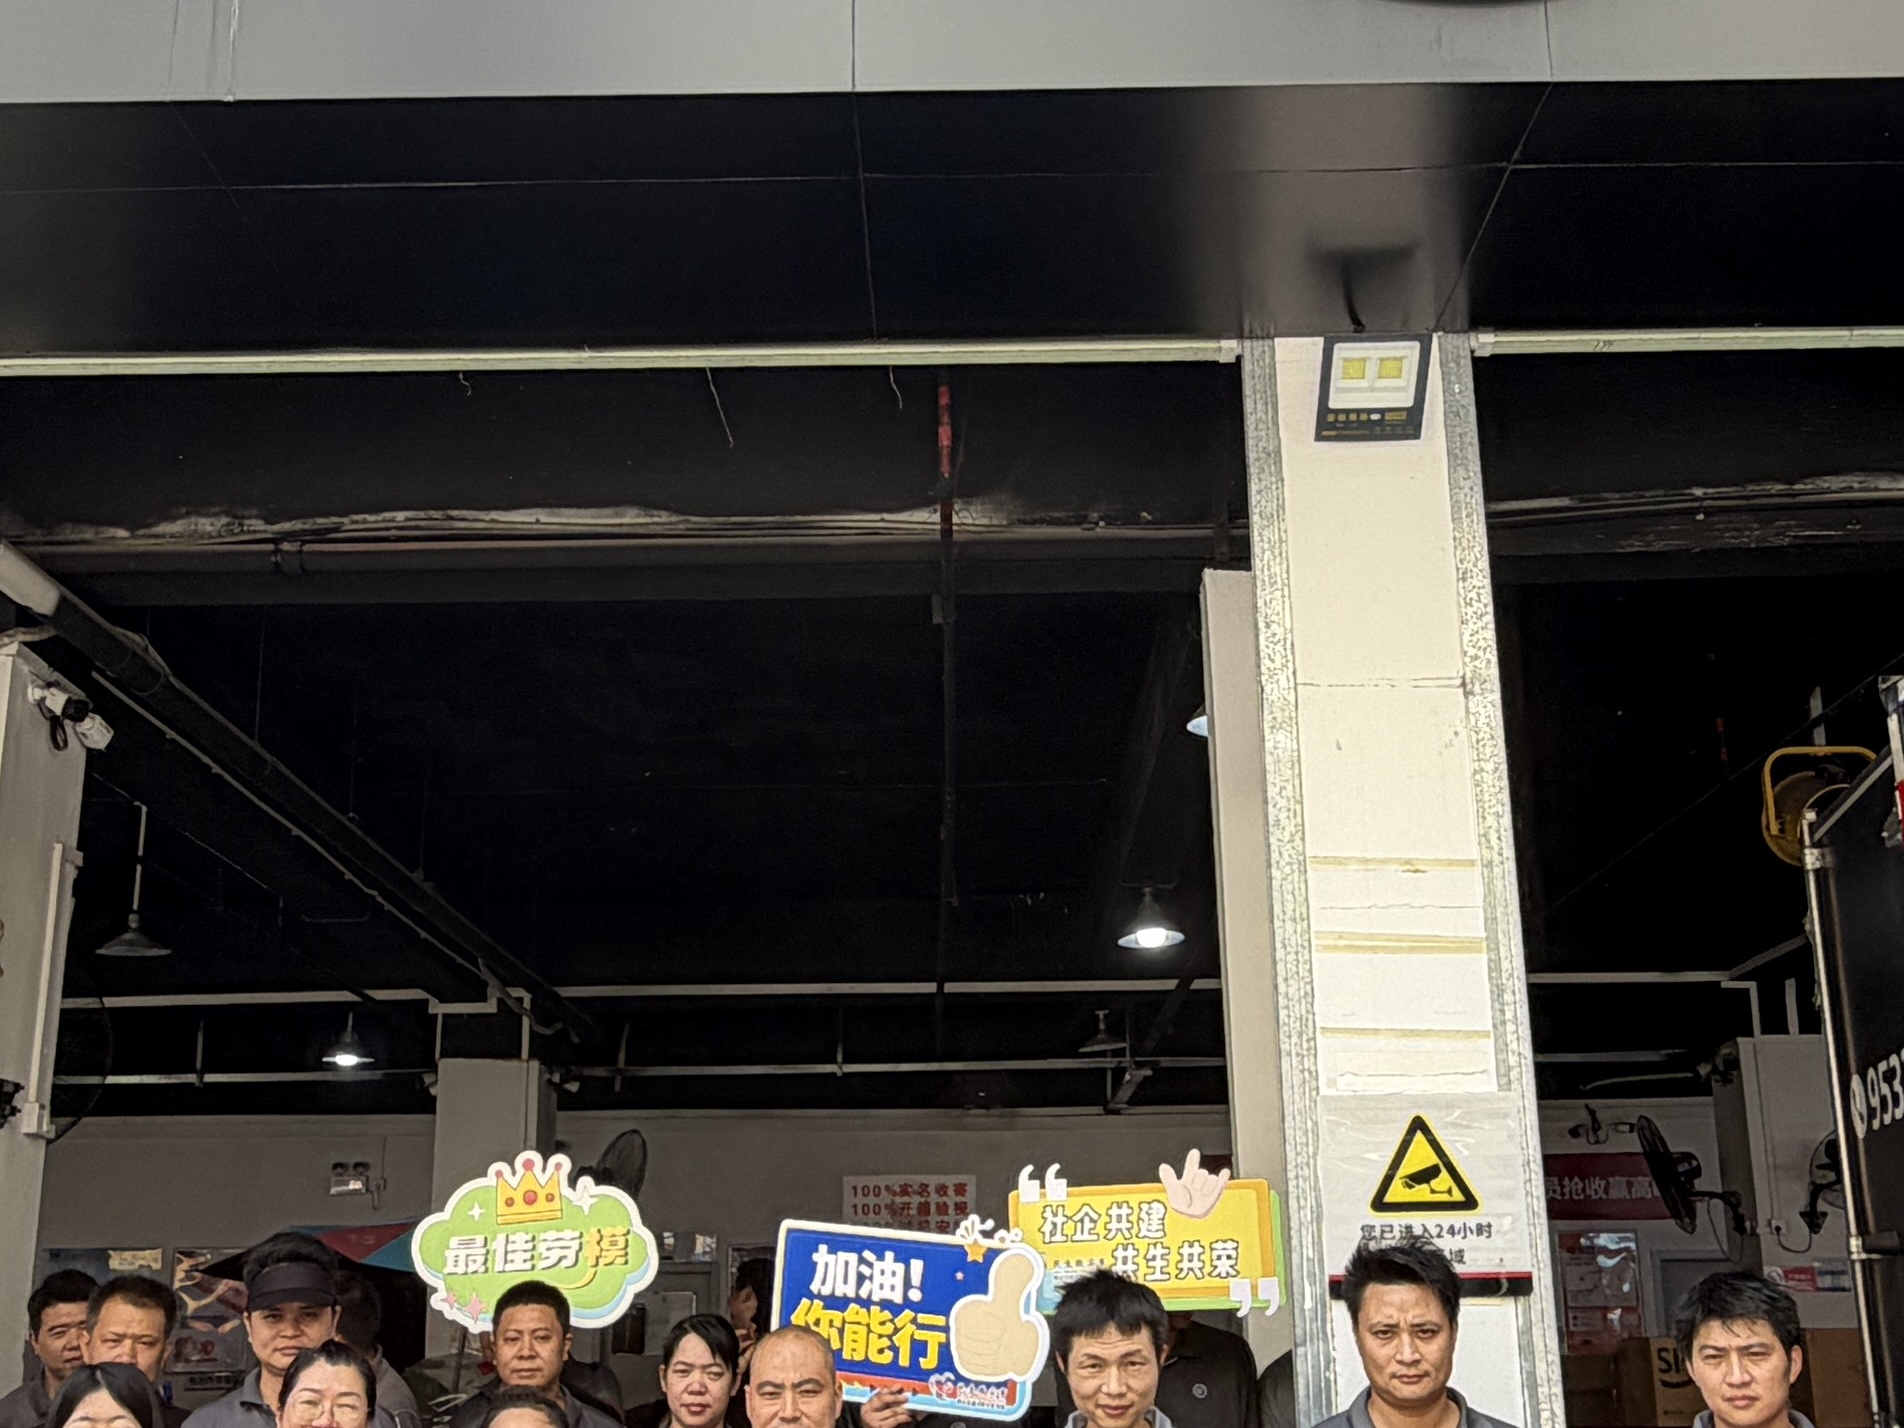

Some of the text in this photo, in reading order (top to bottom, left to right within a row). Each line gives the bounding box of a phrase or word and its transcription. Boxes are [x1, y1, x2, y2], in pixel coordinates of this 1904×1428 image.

[1038, 1199, 1168, 1244] 社企共建
[1359, 1221, 1493, 1241] 您已进入24小时
[443, 1227, 633, 1276] 最佳劳模
[1110, 1238, 1240, 1284] 共生共荣
[791, 1298, 947, 1370] 你能行
